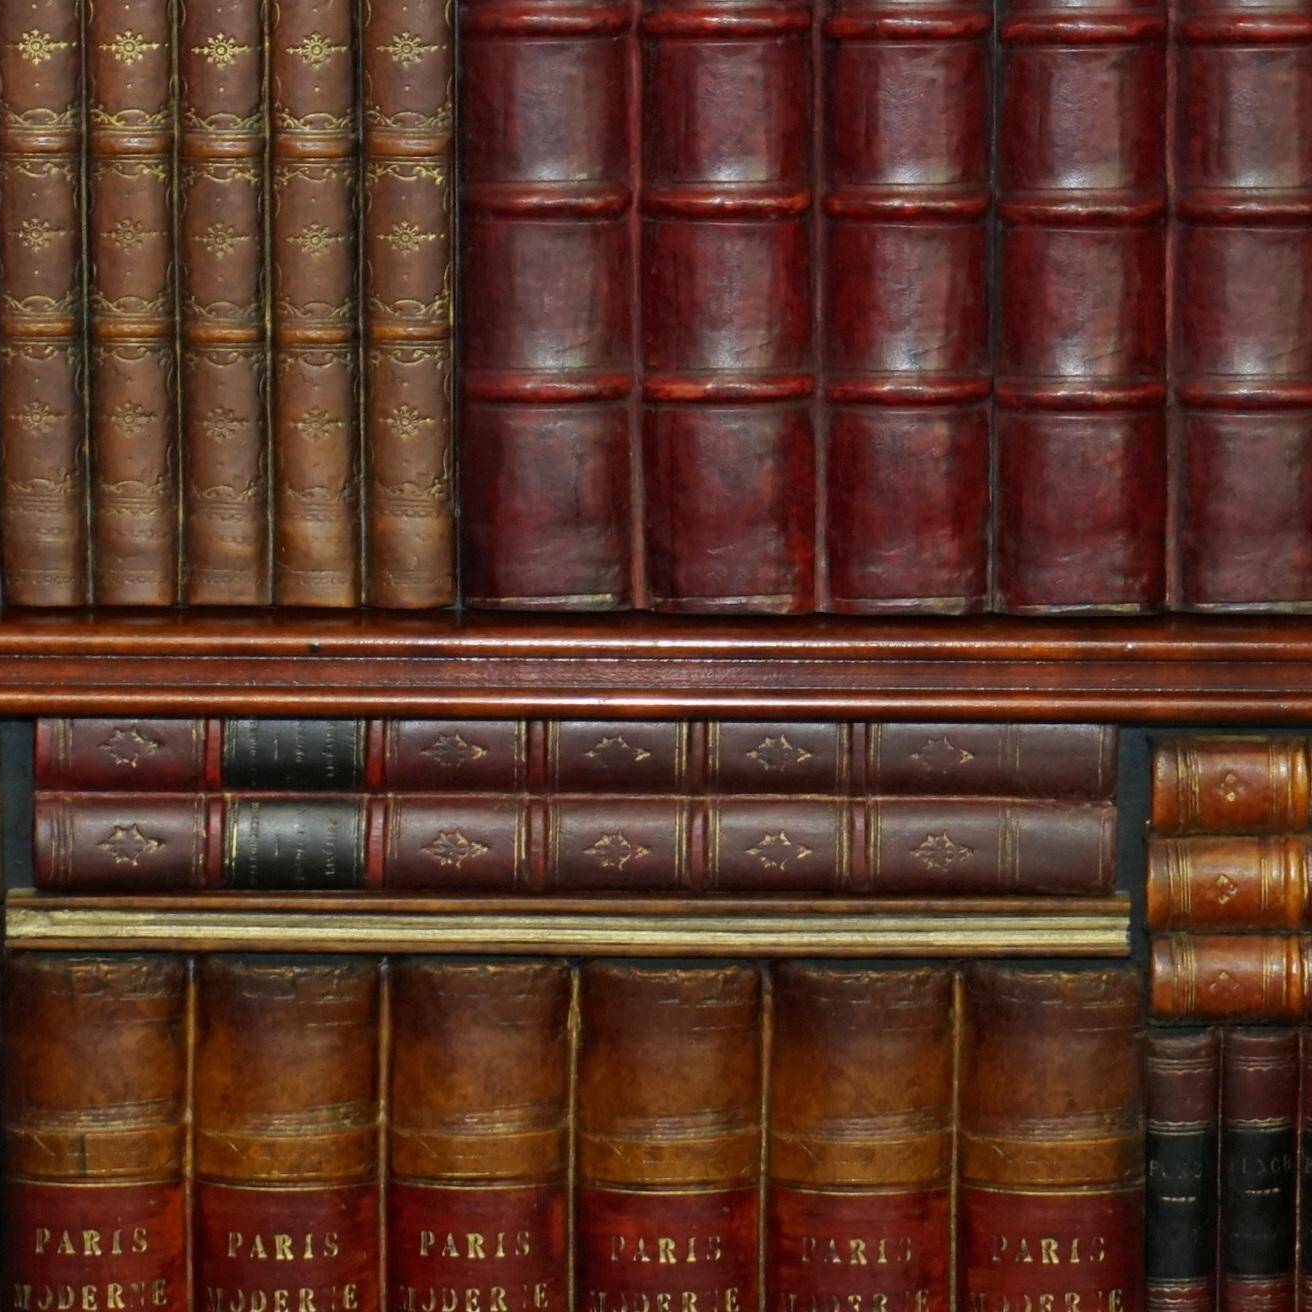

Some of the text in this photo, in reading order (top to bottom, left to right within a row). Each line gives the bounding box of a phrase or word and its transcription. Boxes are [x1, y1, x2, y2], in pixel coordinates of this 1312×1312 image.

[34, 1226, 149, 1257] PARIS
[226, 1230, 340, 1261] PARIS
[419, 1230, 532, 1261] PARIS
[609, 1234, 723, 1264] PARIS
[800, 1234, 913, 1265] PARIS
[991, 1235, 1106, 1265] PARIS
[206, 1283, 359, 1312] MODERE
[398, 1282, 550, 1312] MODERE
